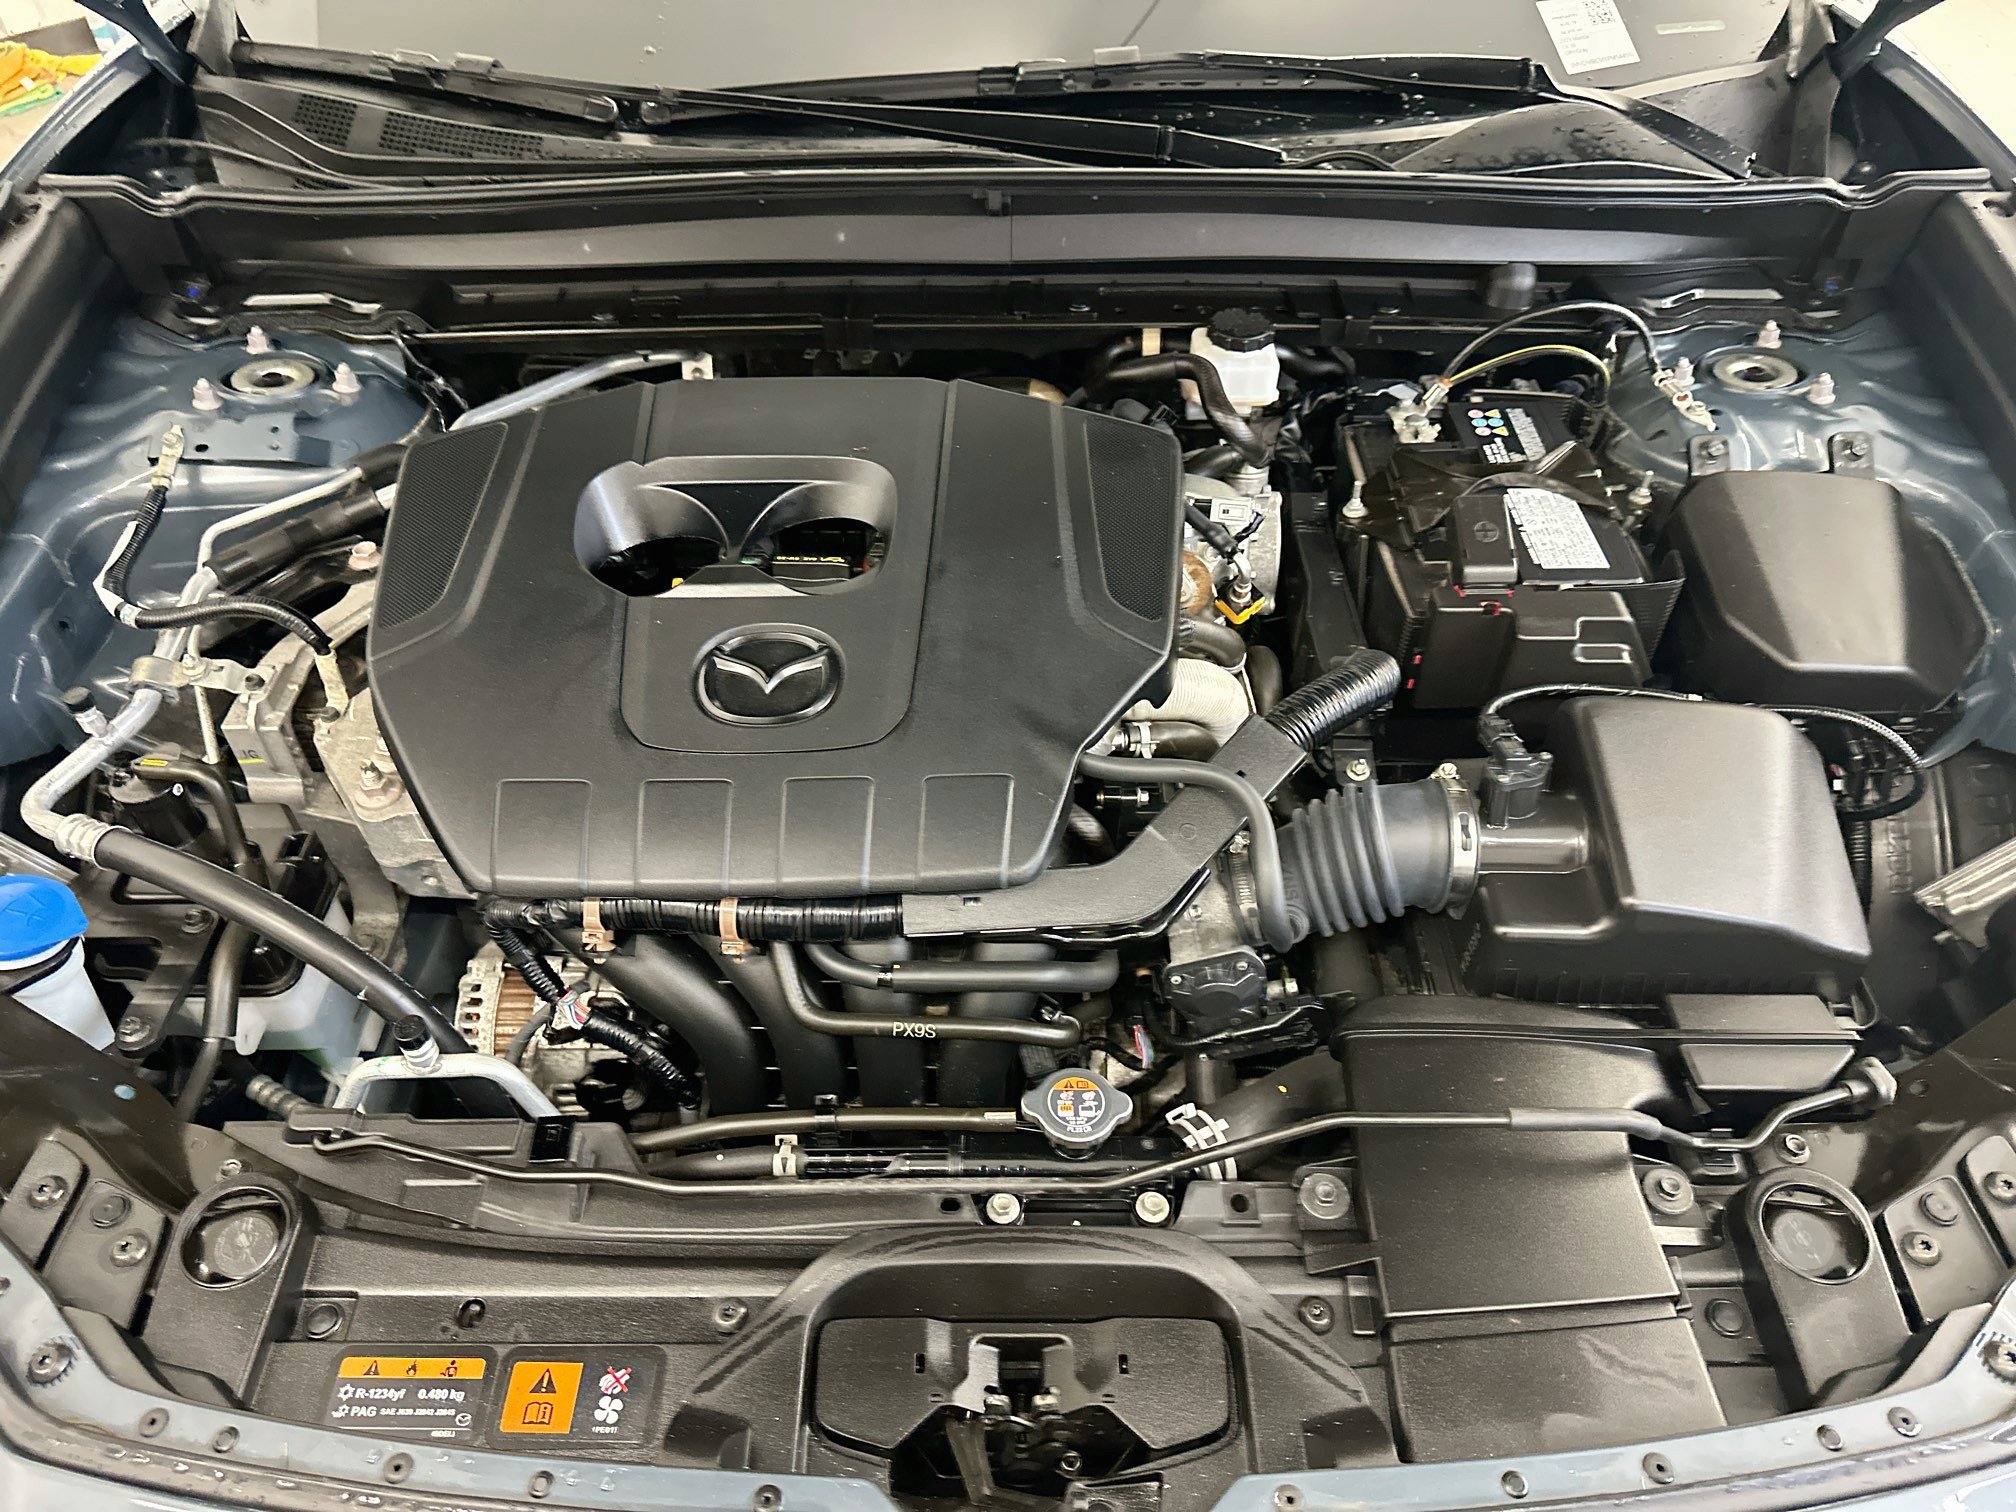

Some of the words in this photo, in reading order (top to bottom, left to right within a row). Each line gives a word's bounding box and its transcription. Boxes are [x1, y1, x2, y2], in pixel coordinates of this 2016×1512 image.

[892, 1021, 937, 1039] PX9S
[355, 1388, 407, 1402] R-1234yf
[449, 1388, 466, 1402] kg
[350, 1406, 378, 1417] PAG
